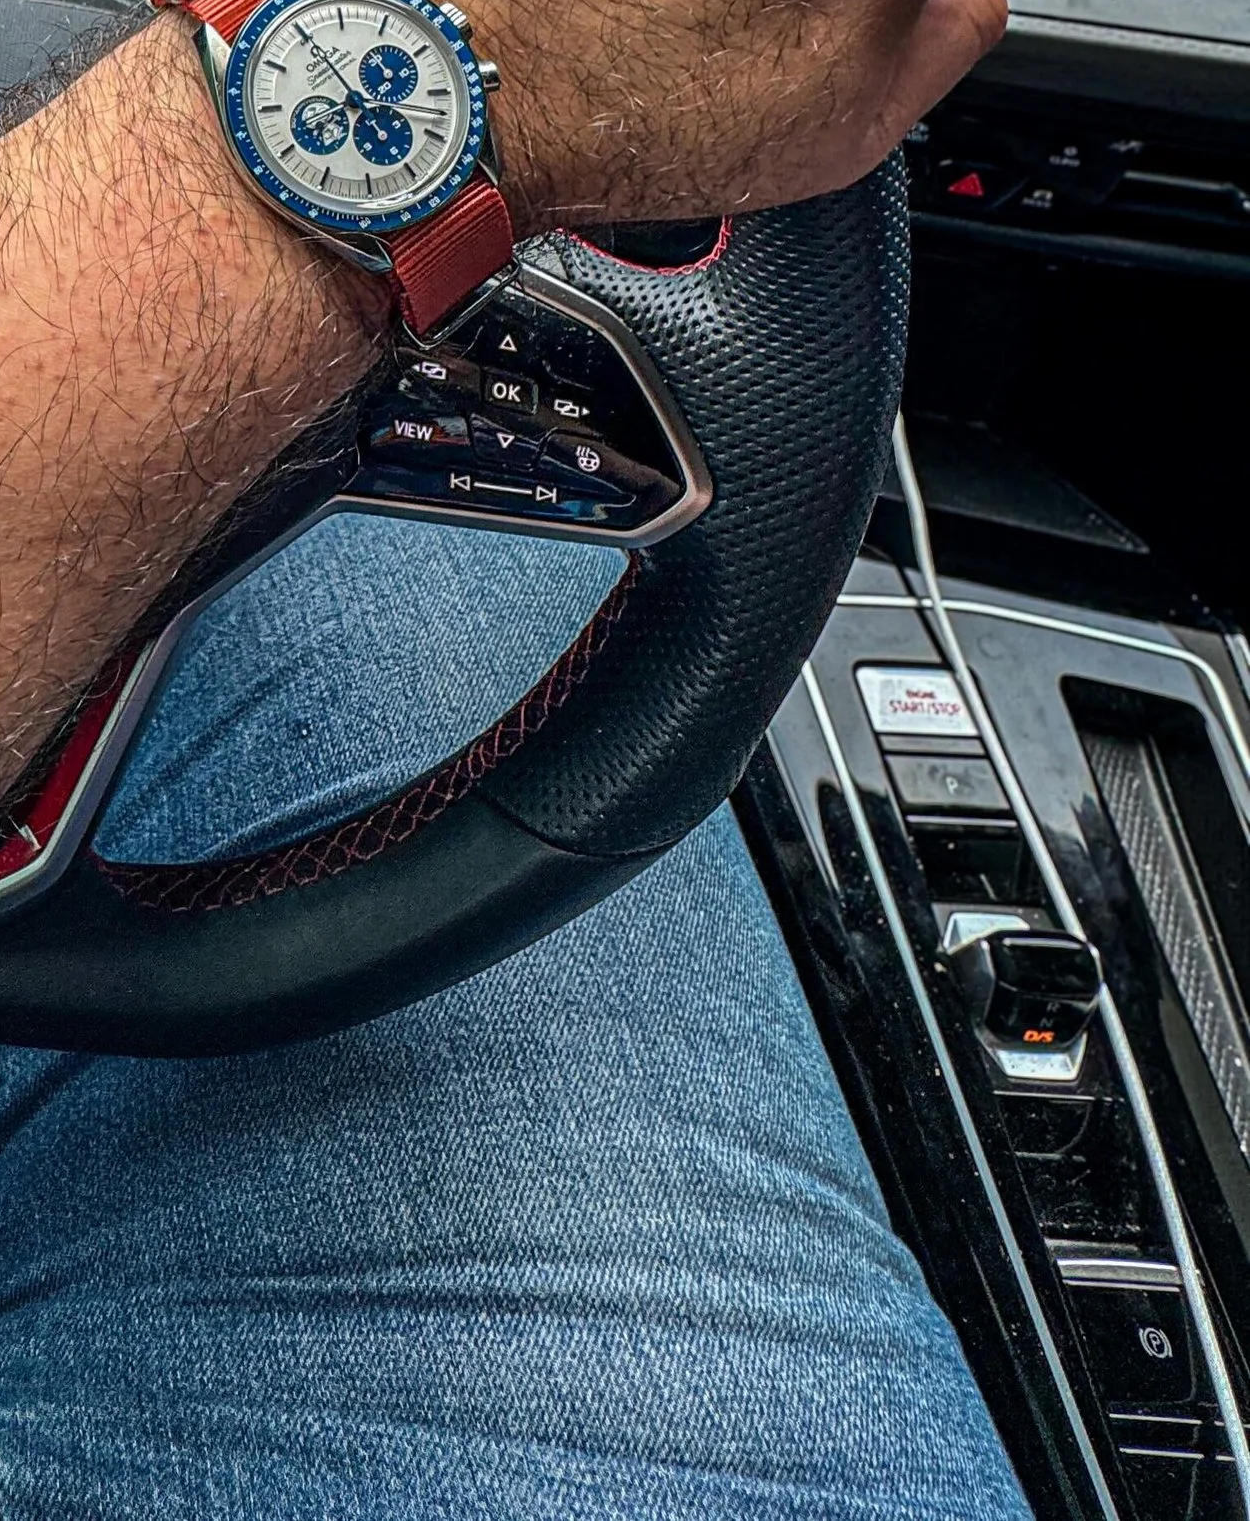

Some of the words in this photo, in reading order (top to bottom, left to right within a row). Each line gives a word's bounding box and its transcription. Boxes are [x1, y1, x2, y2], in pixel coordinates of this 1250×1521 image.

[368, 54, 382, 67] 30
[398, 67, 409, 78] 10
[227, 86, 238, 97] 70
[377, 81, 391, 94] 20
[471, 100, 483, 111] 170
[391, 120, 401, 129] 3
[235, 130, 246, 140] 75
[467, 134, 480, 146] 150
[363, 141, 372, 150] 9
[389, 146, 398, 155] 6
[448, 174, 461, 186] 130
[428, 195, 440, 207] 120
[358, 216, 372, 229] 100
[492, 382, 522, 403] OK
[394, 419, 433, 441] VIEW
[889, 700, 960, 715] START/STOP
[945, 776, 959, 796] P
[1023, 1030, 1055, 1043] D/S
